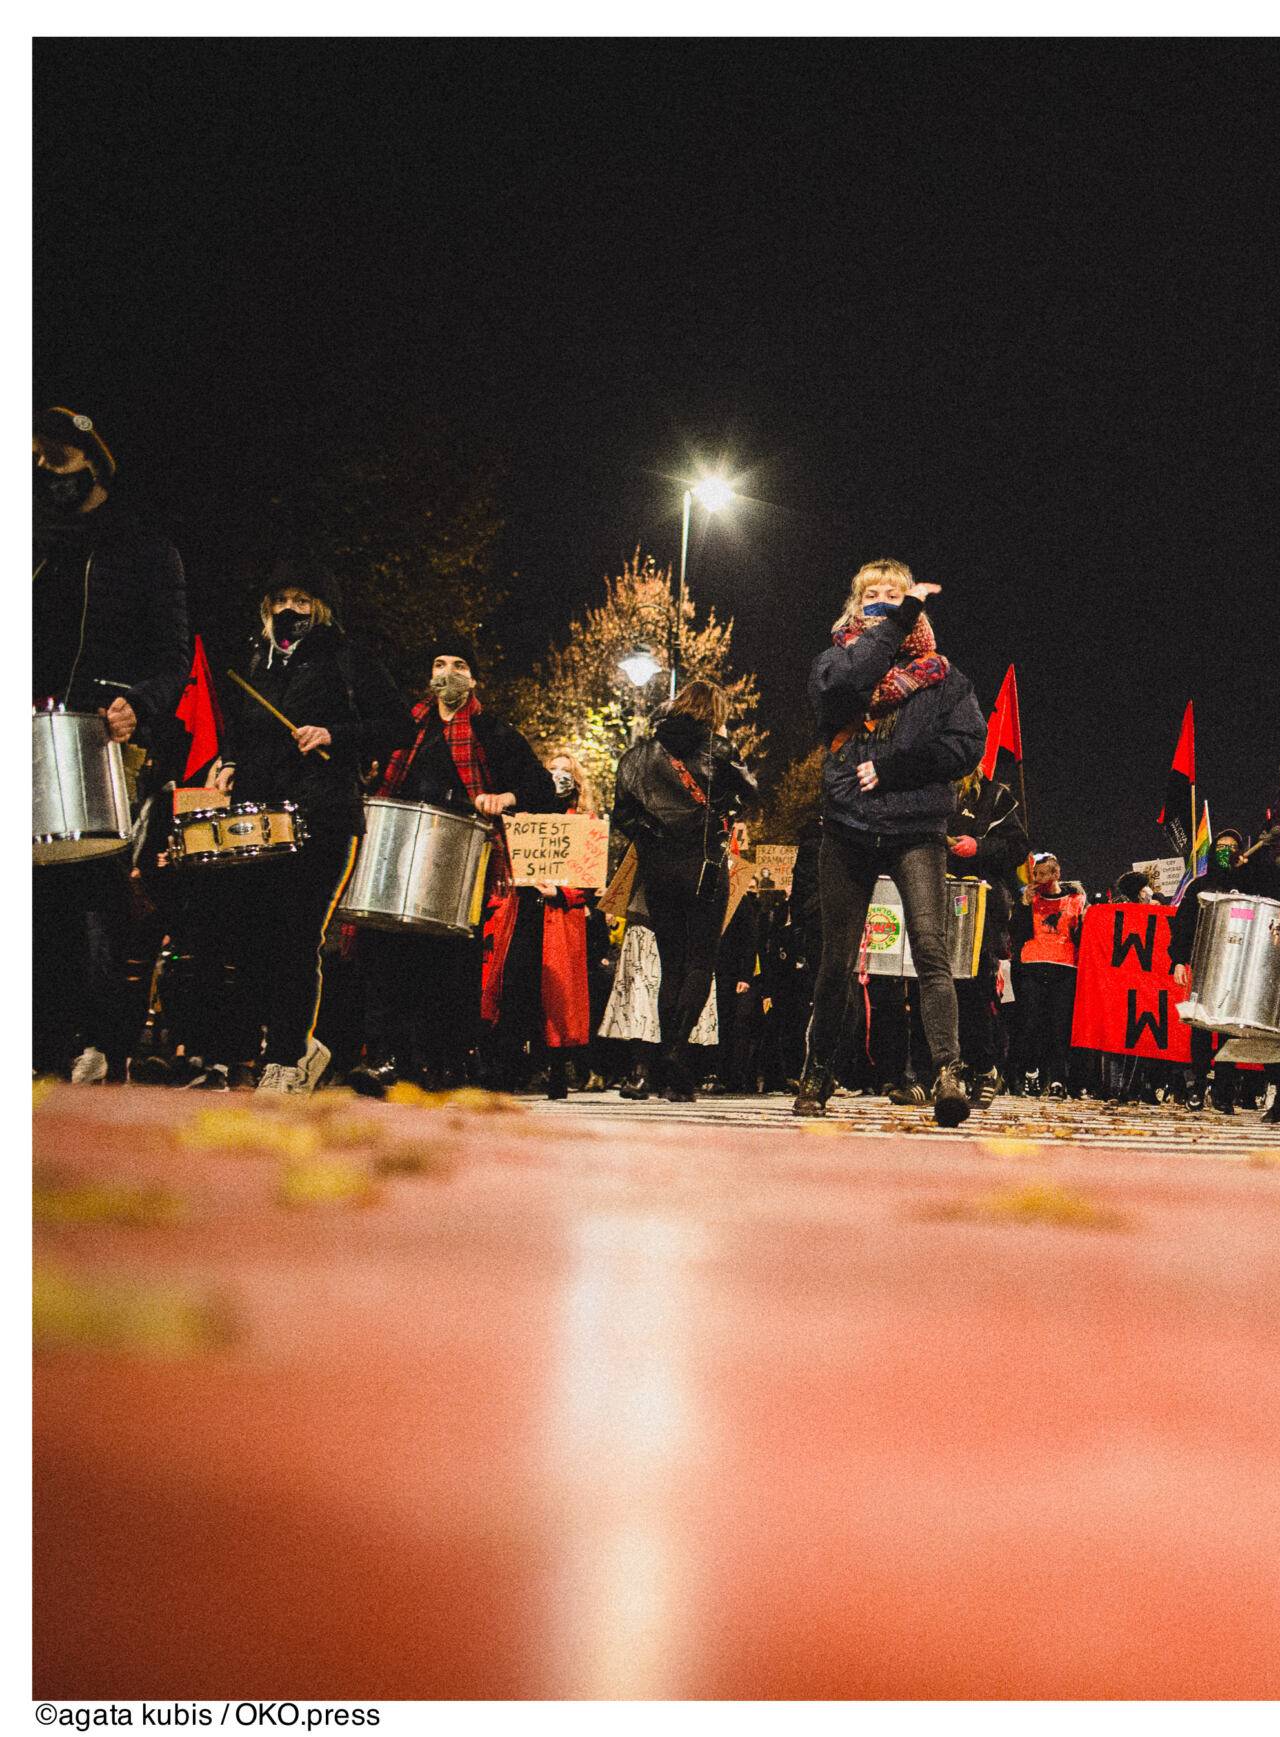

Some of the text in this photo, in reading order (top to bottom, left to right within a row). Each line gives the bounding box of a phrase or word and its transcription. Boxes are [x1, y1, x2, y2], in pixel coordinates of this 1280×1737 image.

[503, 822, 571, 835] PROTEST
[540, 836, 571, 849] THIS
[512, 849, 570, 860] FUCKING
[526, 861, 565, 876] SHIT
